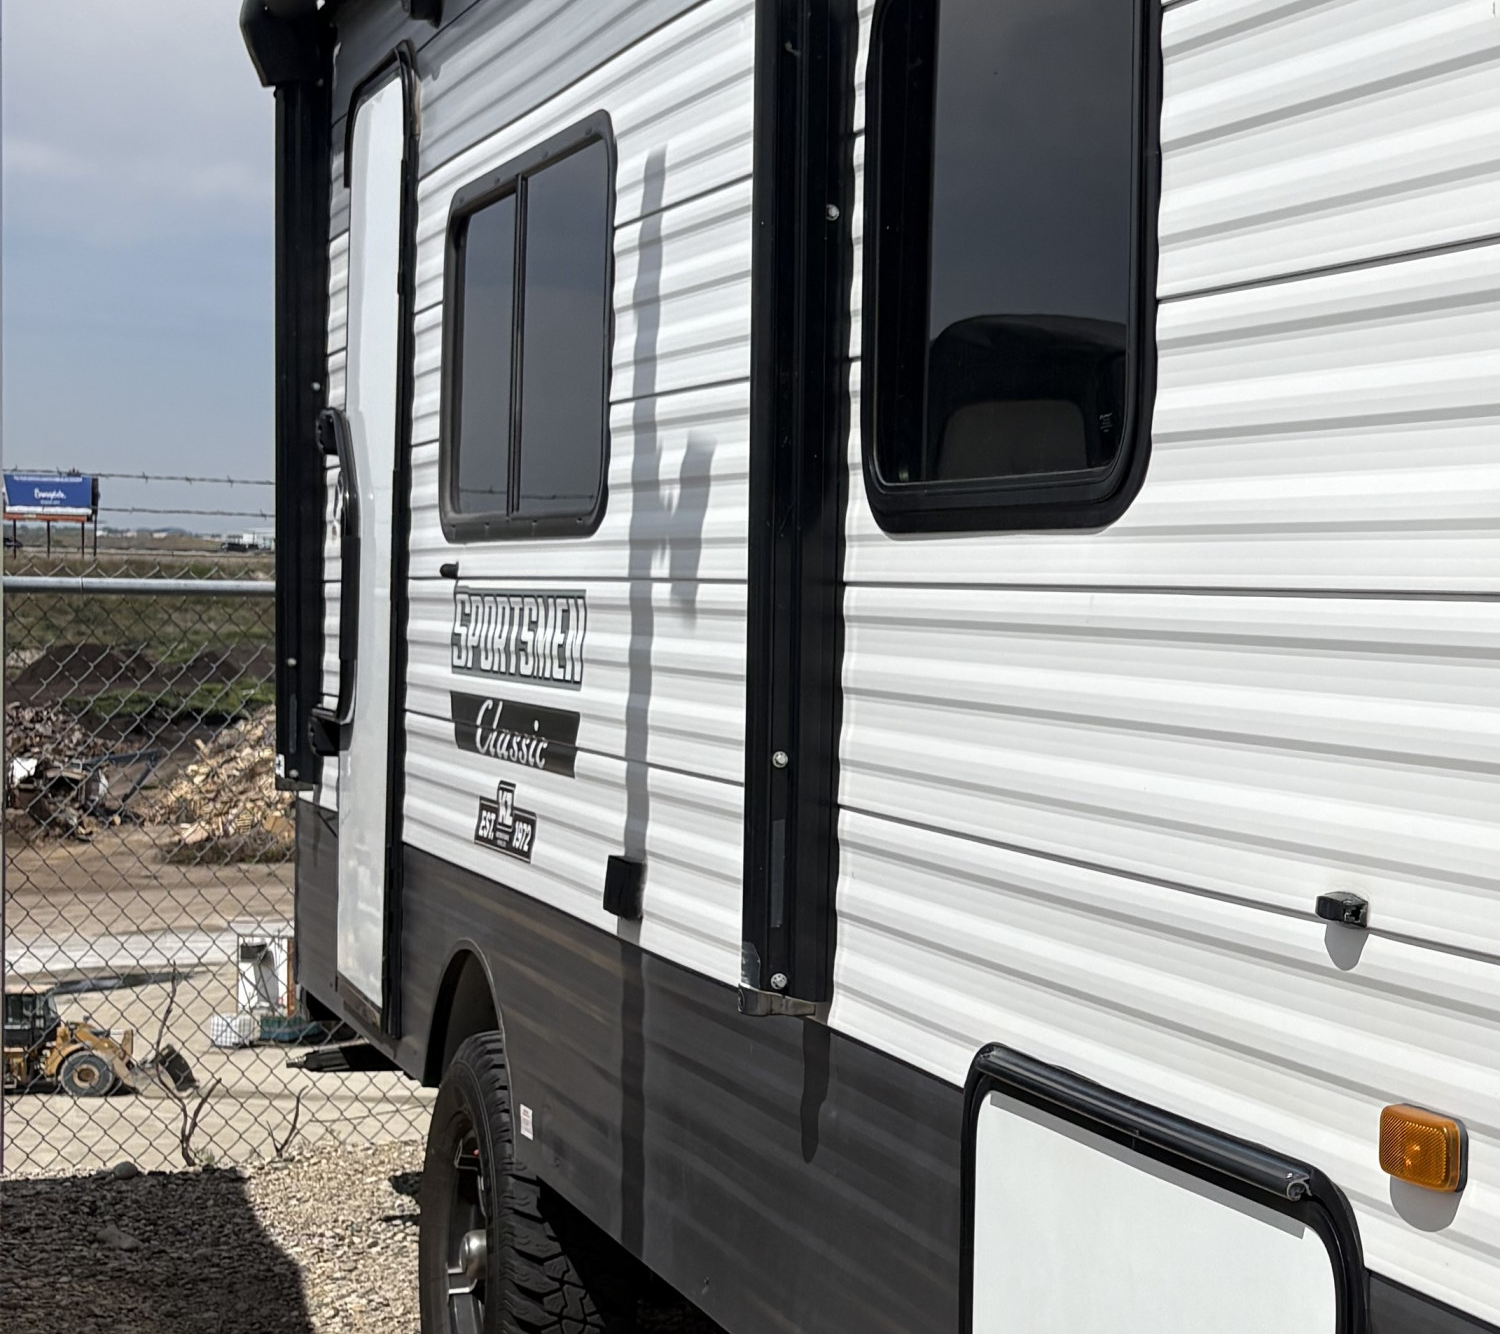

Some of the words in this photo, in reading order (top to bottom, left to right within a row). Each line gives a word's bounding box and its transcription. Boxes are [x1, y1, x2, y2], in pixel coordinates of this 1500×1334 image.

[452, 593, 587, 684] SPORTSMEN
[476, 699, 548, 768] Classic
[479, 809, 496, 840] EST.
[512, 820, 532, 852] 1972
